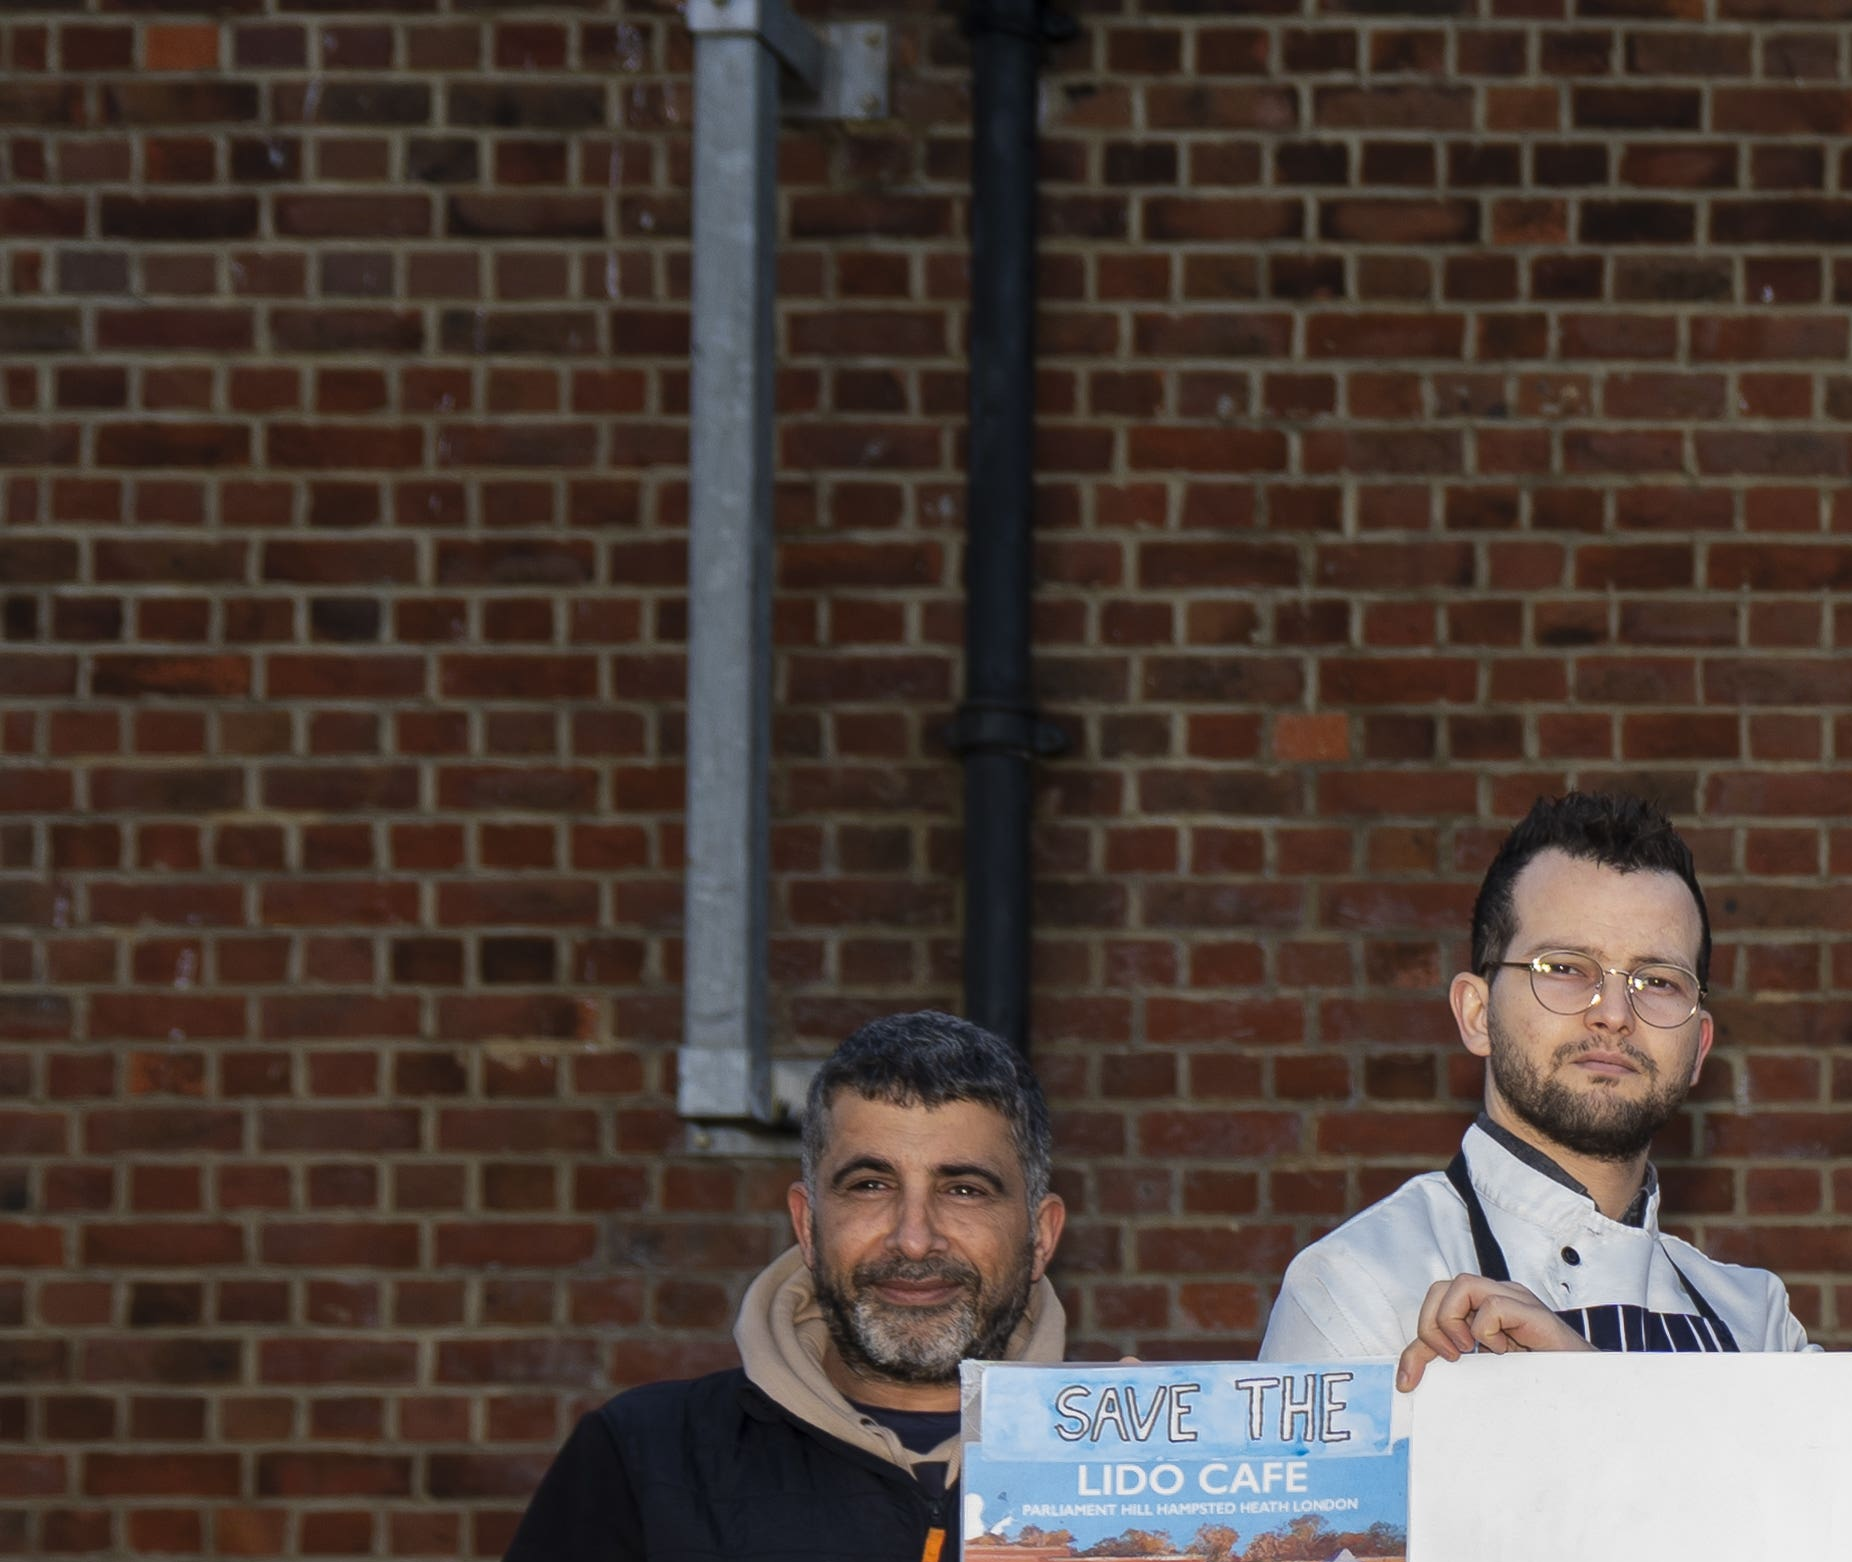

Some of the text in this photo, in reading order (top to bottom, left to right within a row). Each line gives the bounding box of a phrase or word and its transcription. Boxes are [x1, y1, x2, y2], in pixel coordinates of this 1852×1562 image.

[1054, 1372, 1354, 1443] SAVE THE
[1077, 1461, 1309, 1497] LIDO CAFE
[1021, 1503, 1117, 1517] PARLIAMENT
[1156, 1502, 1236, 1516] HAMPSTED
[1240, 1500, 1290, 1514] HEATH
[1293, 1497, 1359, 1513] LONDON
